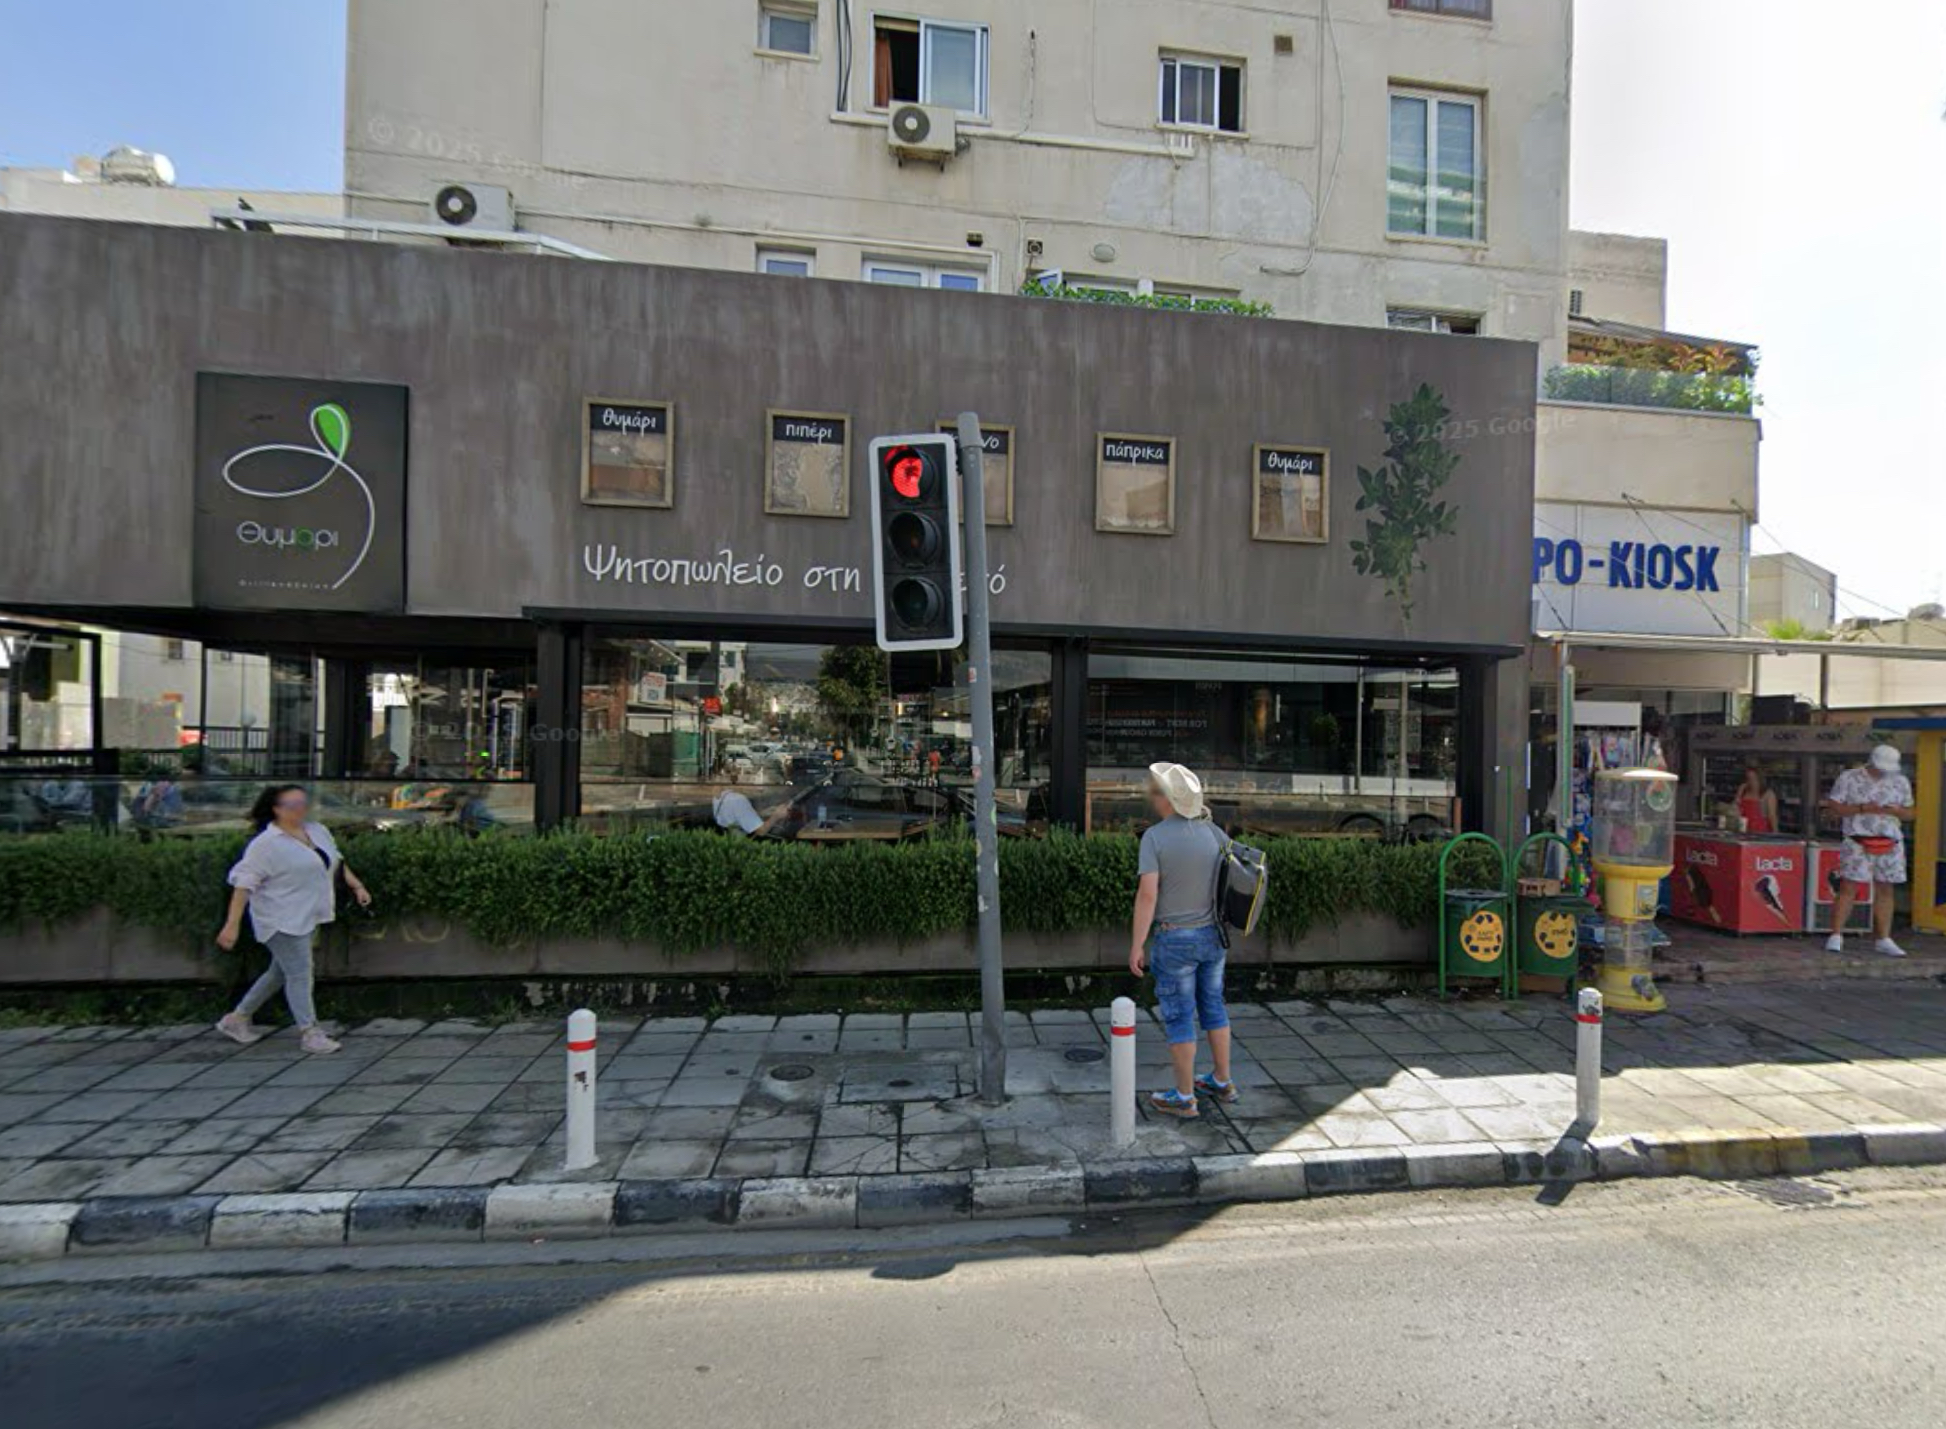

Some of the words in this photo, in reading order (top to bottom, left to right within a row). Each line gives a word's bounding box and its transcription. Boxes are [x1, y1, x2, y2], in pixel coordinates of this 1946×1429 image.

[602, 407, 657, 437] θυμάρι
[785, 422, 832, 445] πιπέρι
[1106, 441, 1164, 467] πάπρικα
[1267, 451, 1313, 478] θυμάρι
[584, 544, 784, 586] Ψητοπωλείο
[803, 565, 861, 592] στη
[1756, 855, 1793, 872] Lacta
